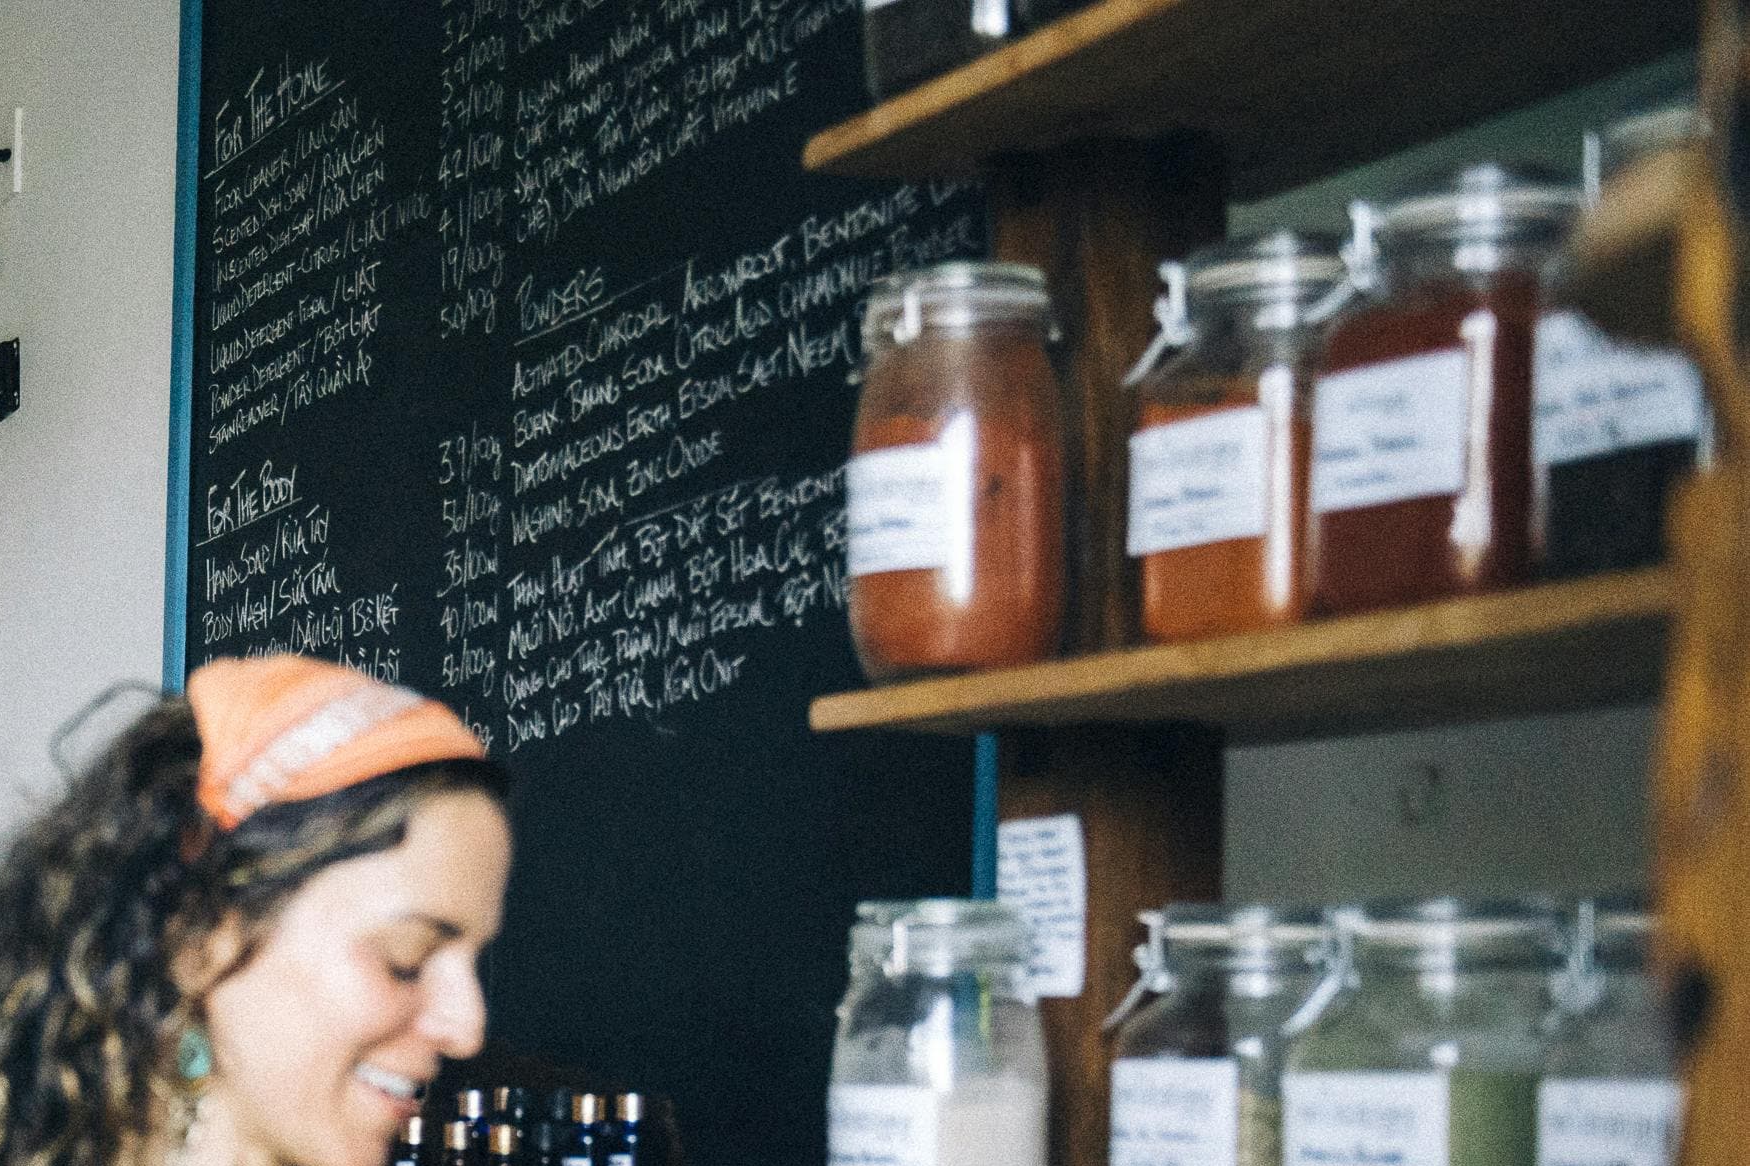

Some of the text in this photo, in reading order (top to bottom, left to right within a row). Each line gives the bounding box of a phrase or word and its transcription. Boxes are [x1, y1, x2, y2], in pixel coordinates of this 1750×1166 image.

[245, 66, 275, 140] THE
[277, 51, 330, 119] HOME
[207, 458, 298, 539] FOR THE BODY
[202, 605, 234, 645] BODY
